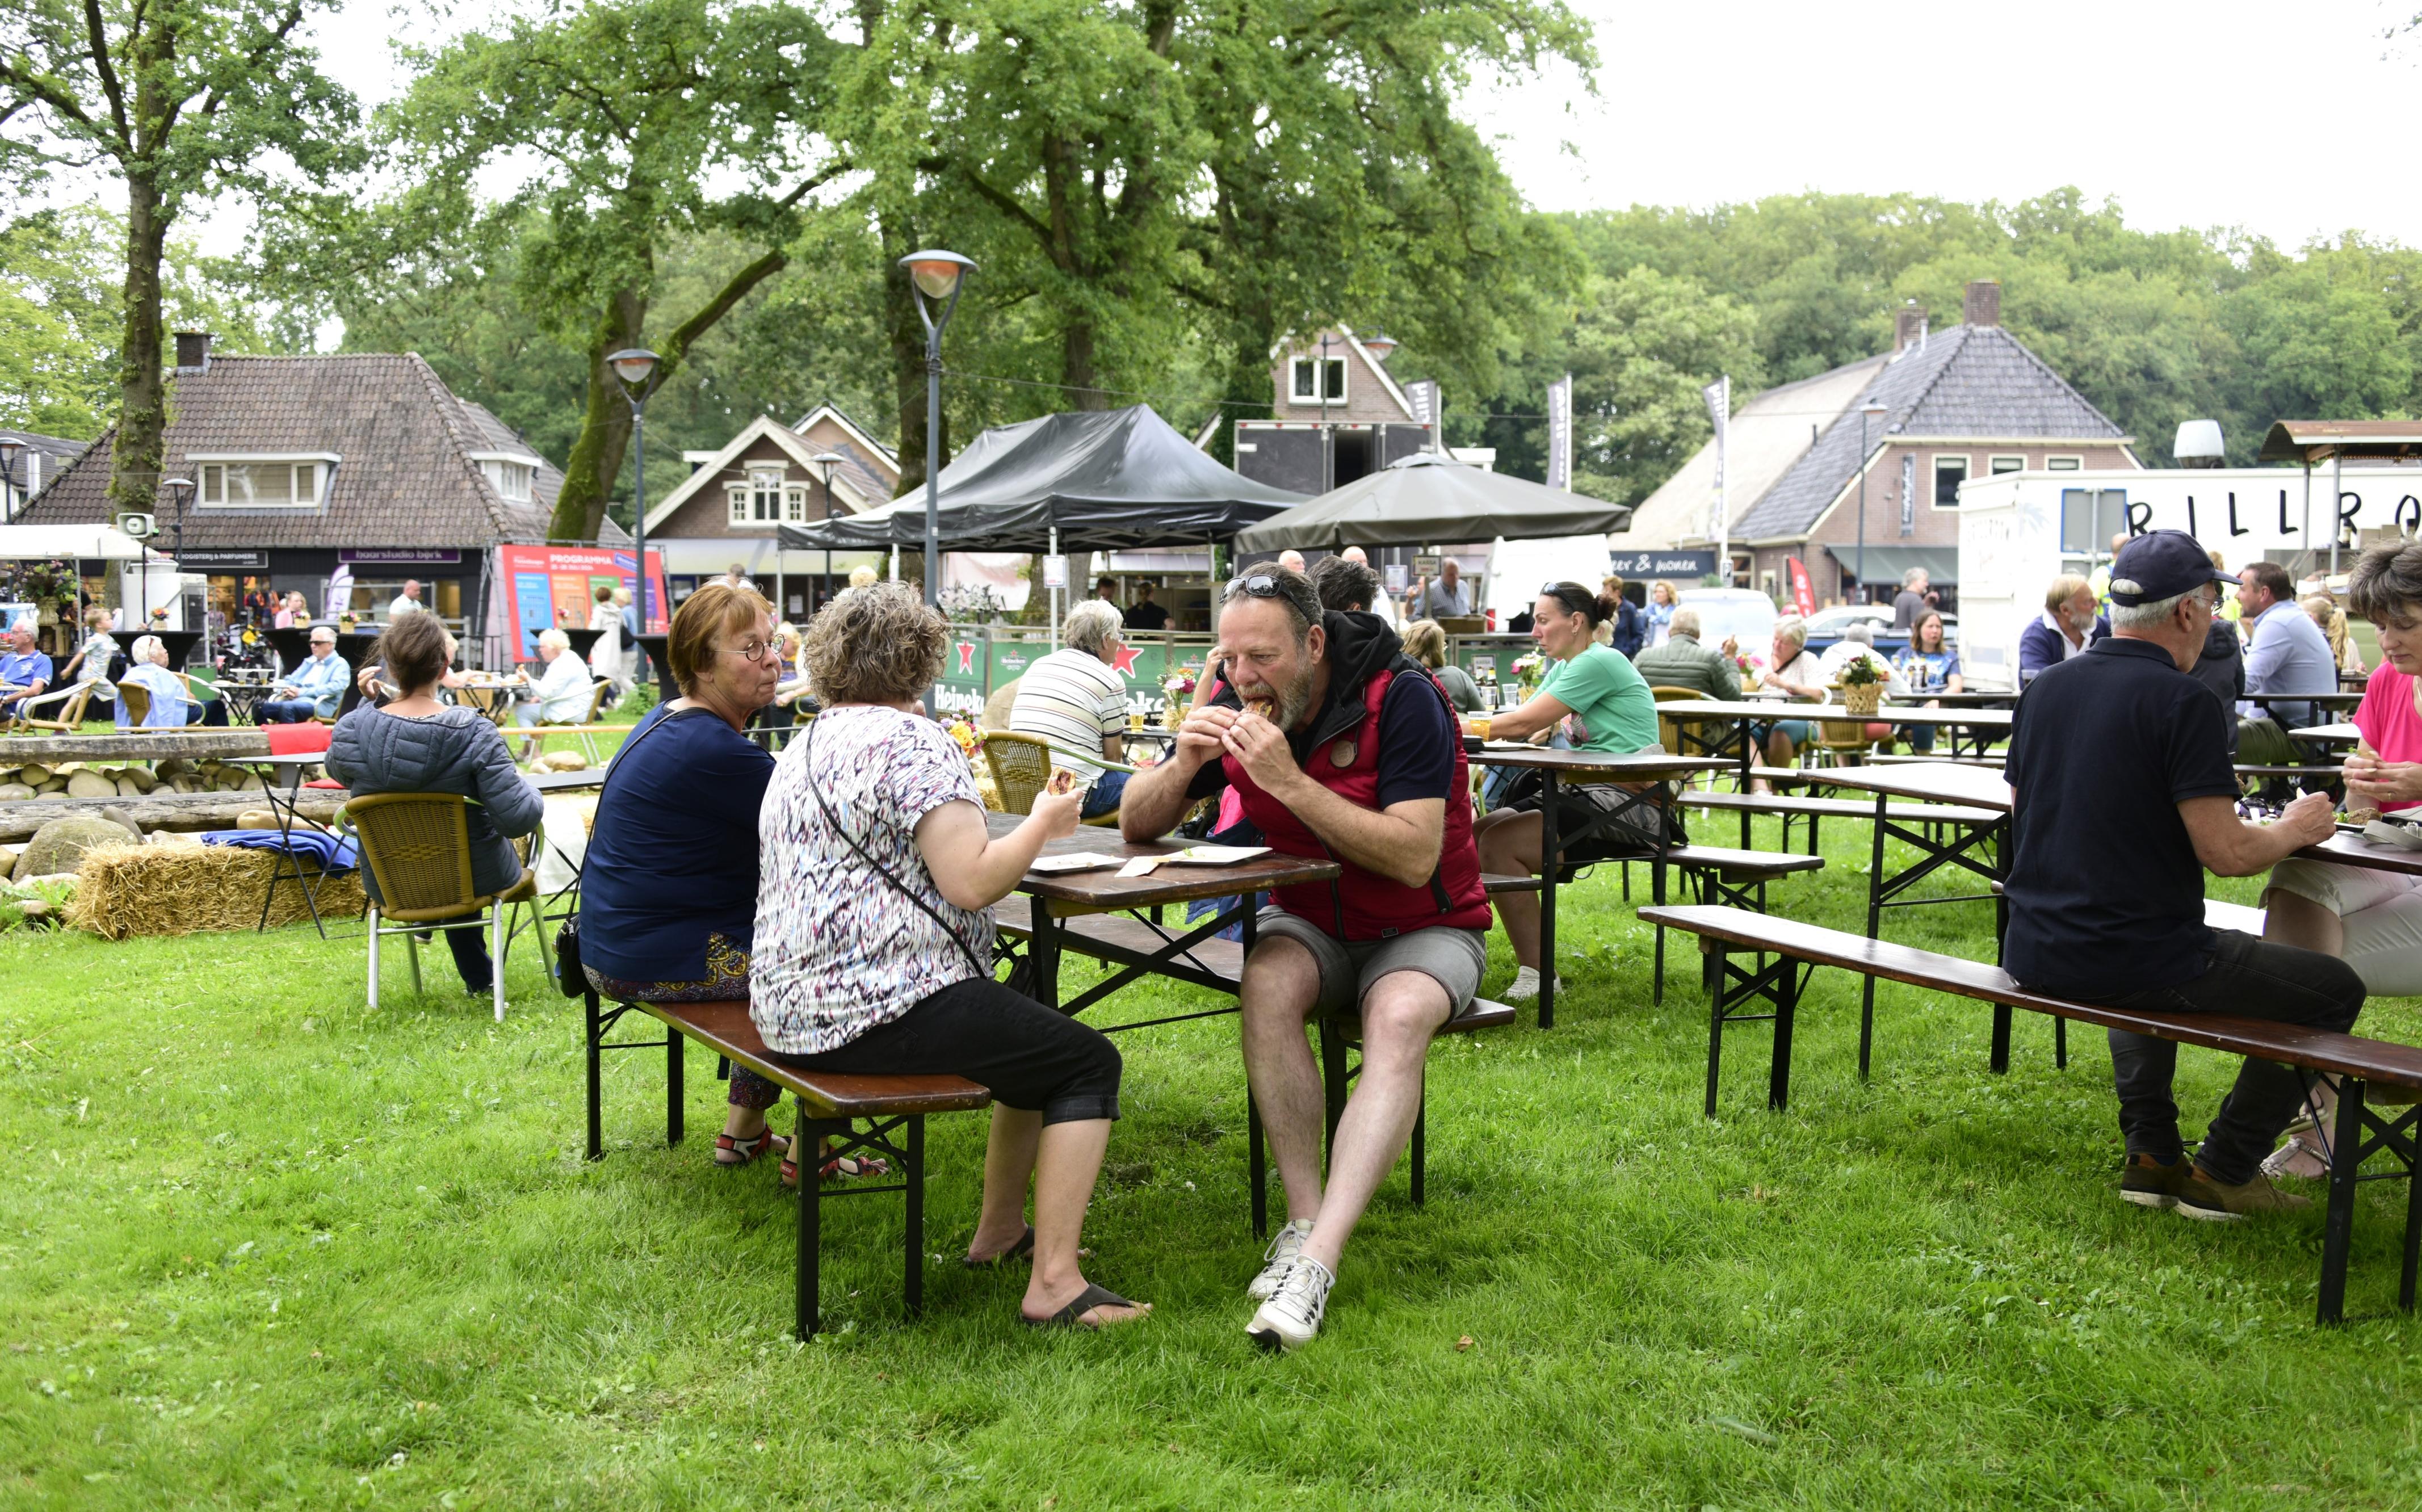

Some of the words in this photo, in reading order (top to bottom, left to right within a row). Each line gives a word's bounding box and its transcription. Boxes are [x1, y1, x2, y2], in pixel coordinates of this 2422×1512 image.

[355, 550, 415, 560] haarstudio
[549, 554, 613, 565] PROGRAMMA
[1635, 553, 1651, 572] &
[1656, 559, 1698, 573] wonen
